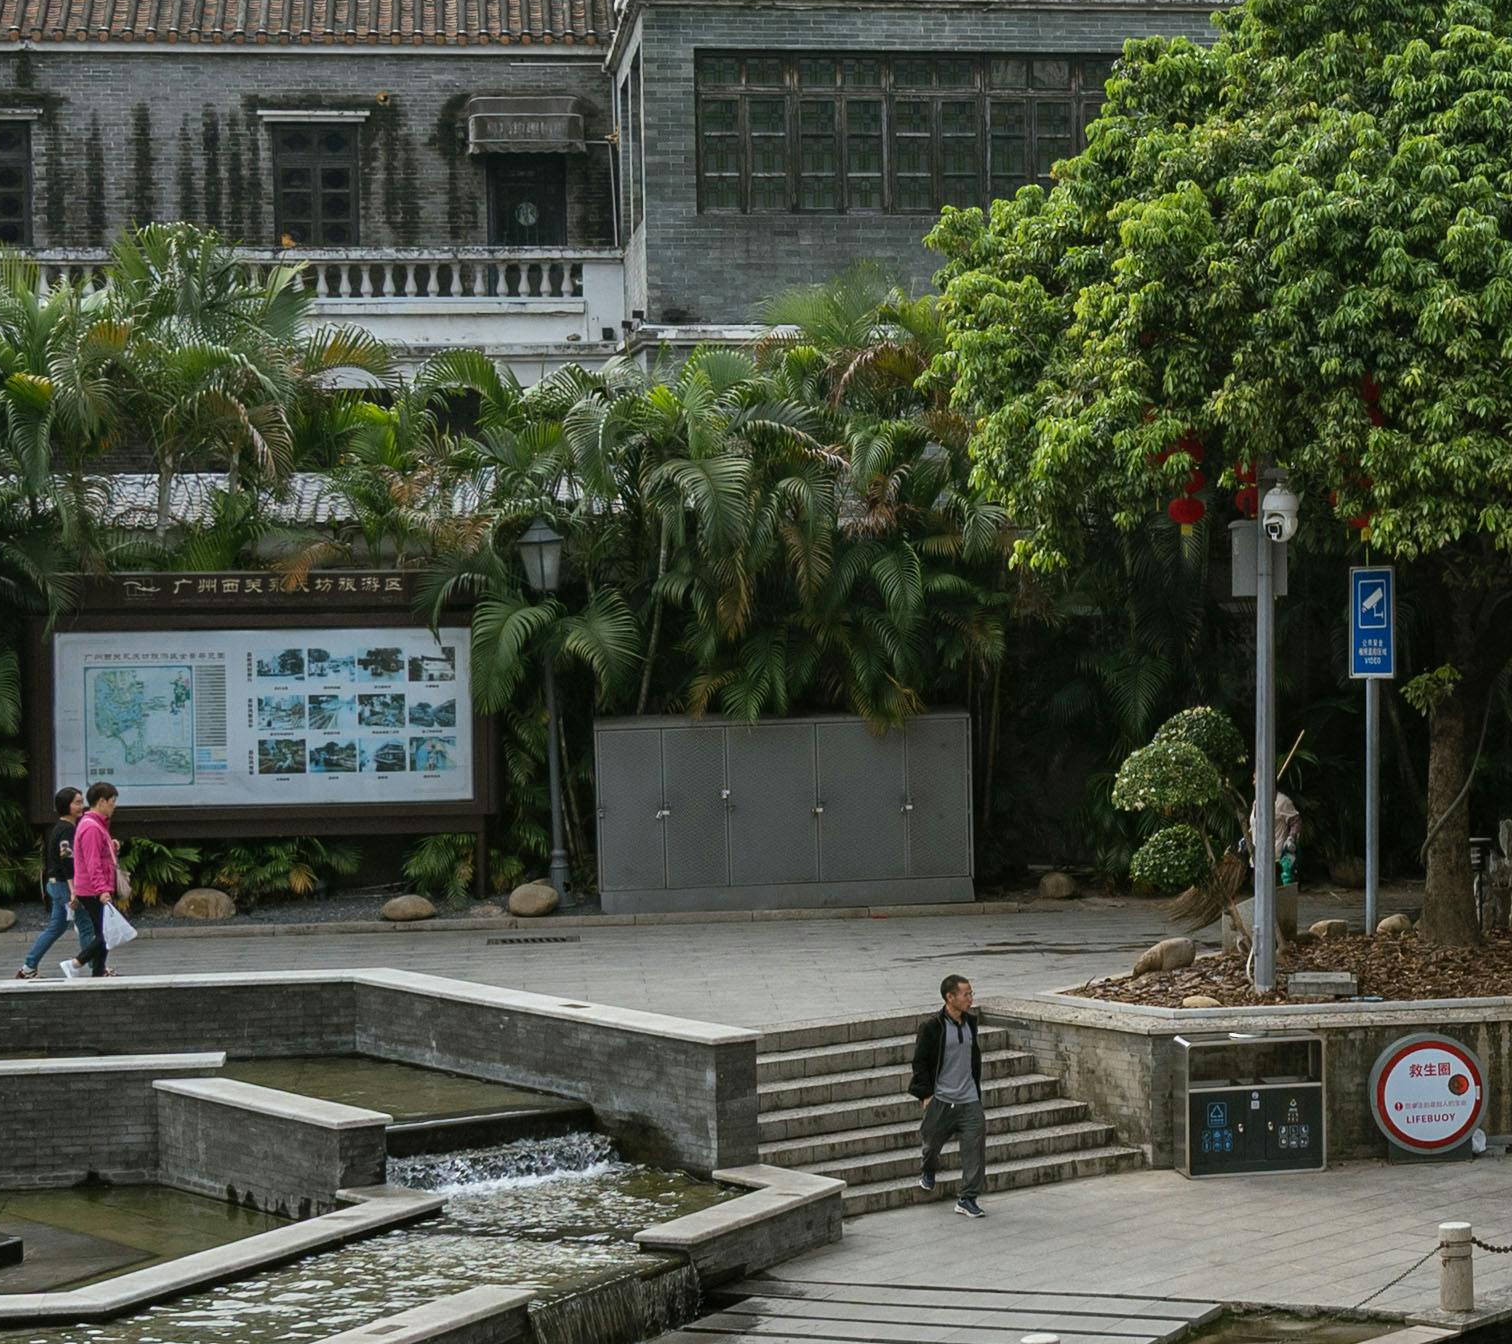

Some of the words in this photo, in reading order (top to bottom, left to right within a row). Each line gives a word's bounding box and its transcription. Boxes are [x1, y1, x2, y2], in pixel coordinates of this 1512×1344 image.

[1408, 1062, 1451, 1078] 救生圈
[1406, 1113, 1456, 1124] LIFEBUOY
